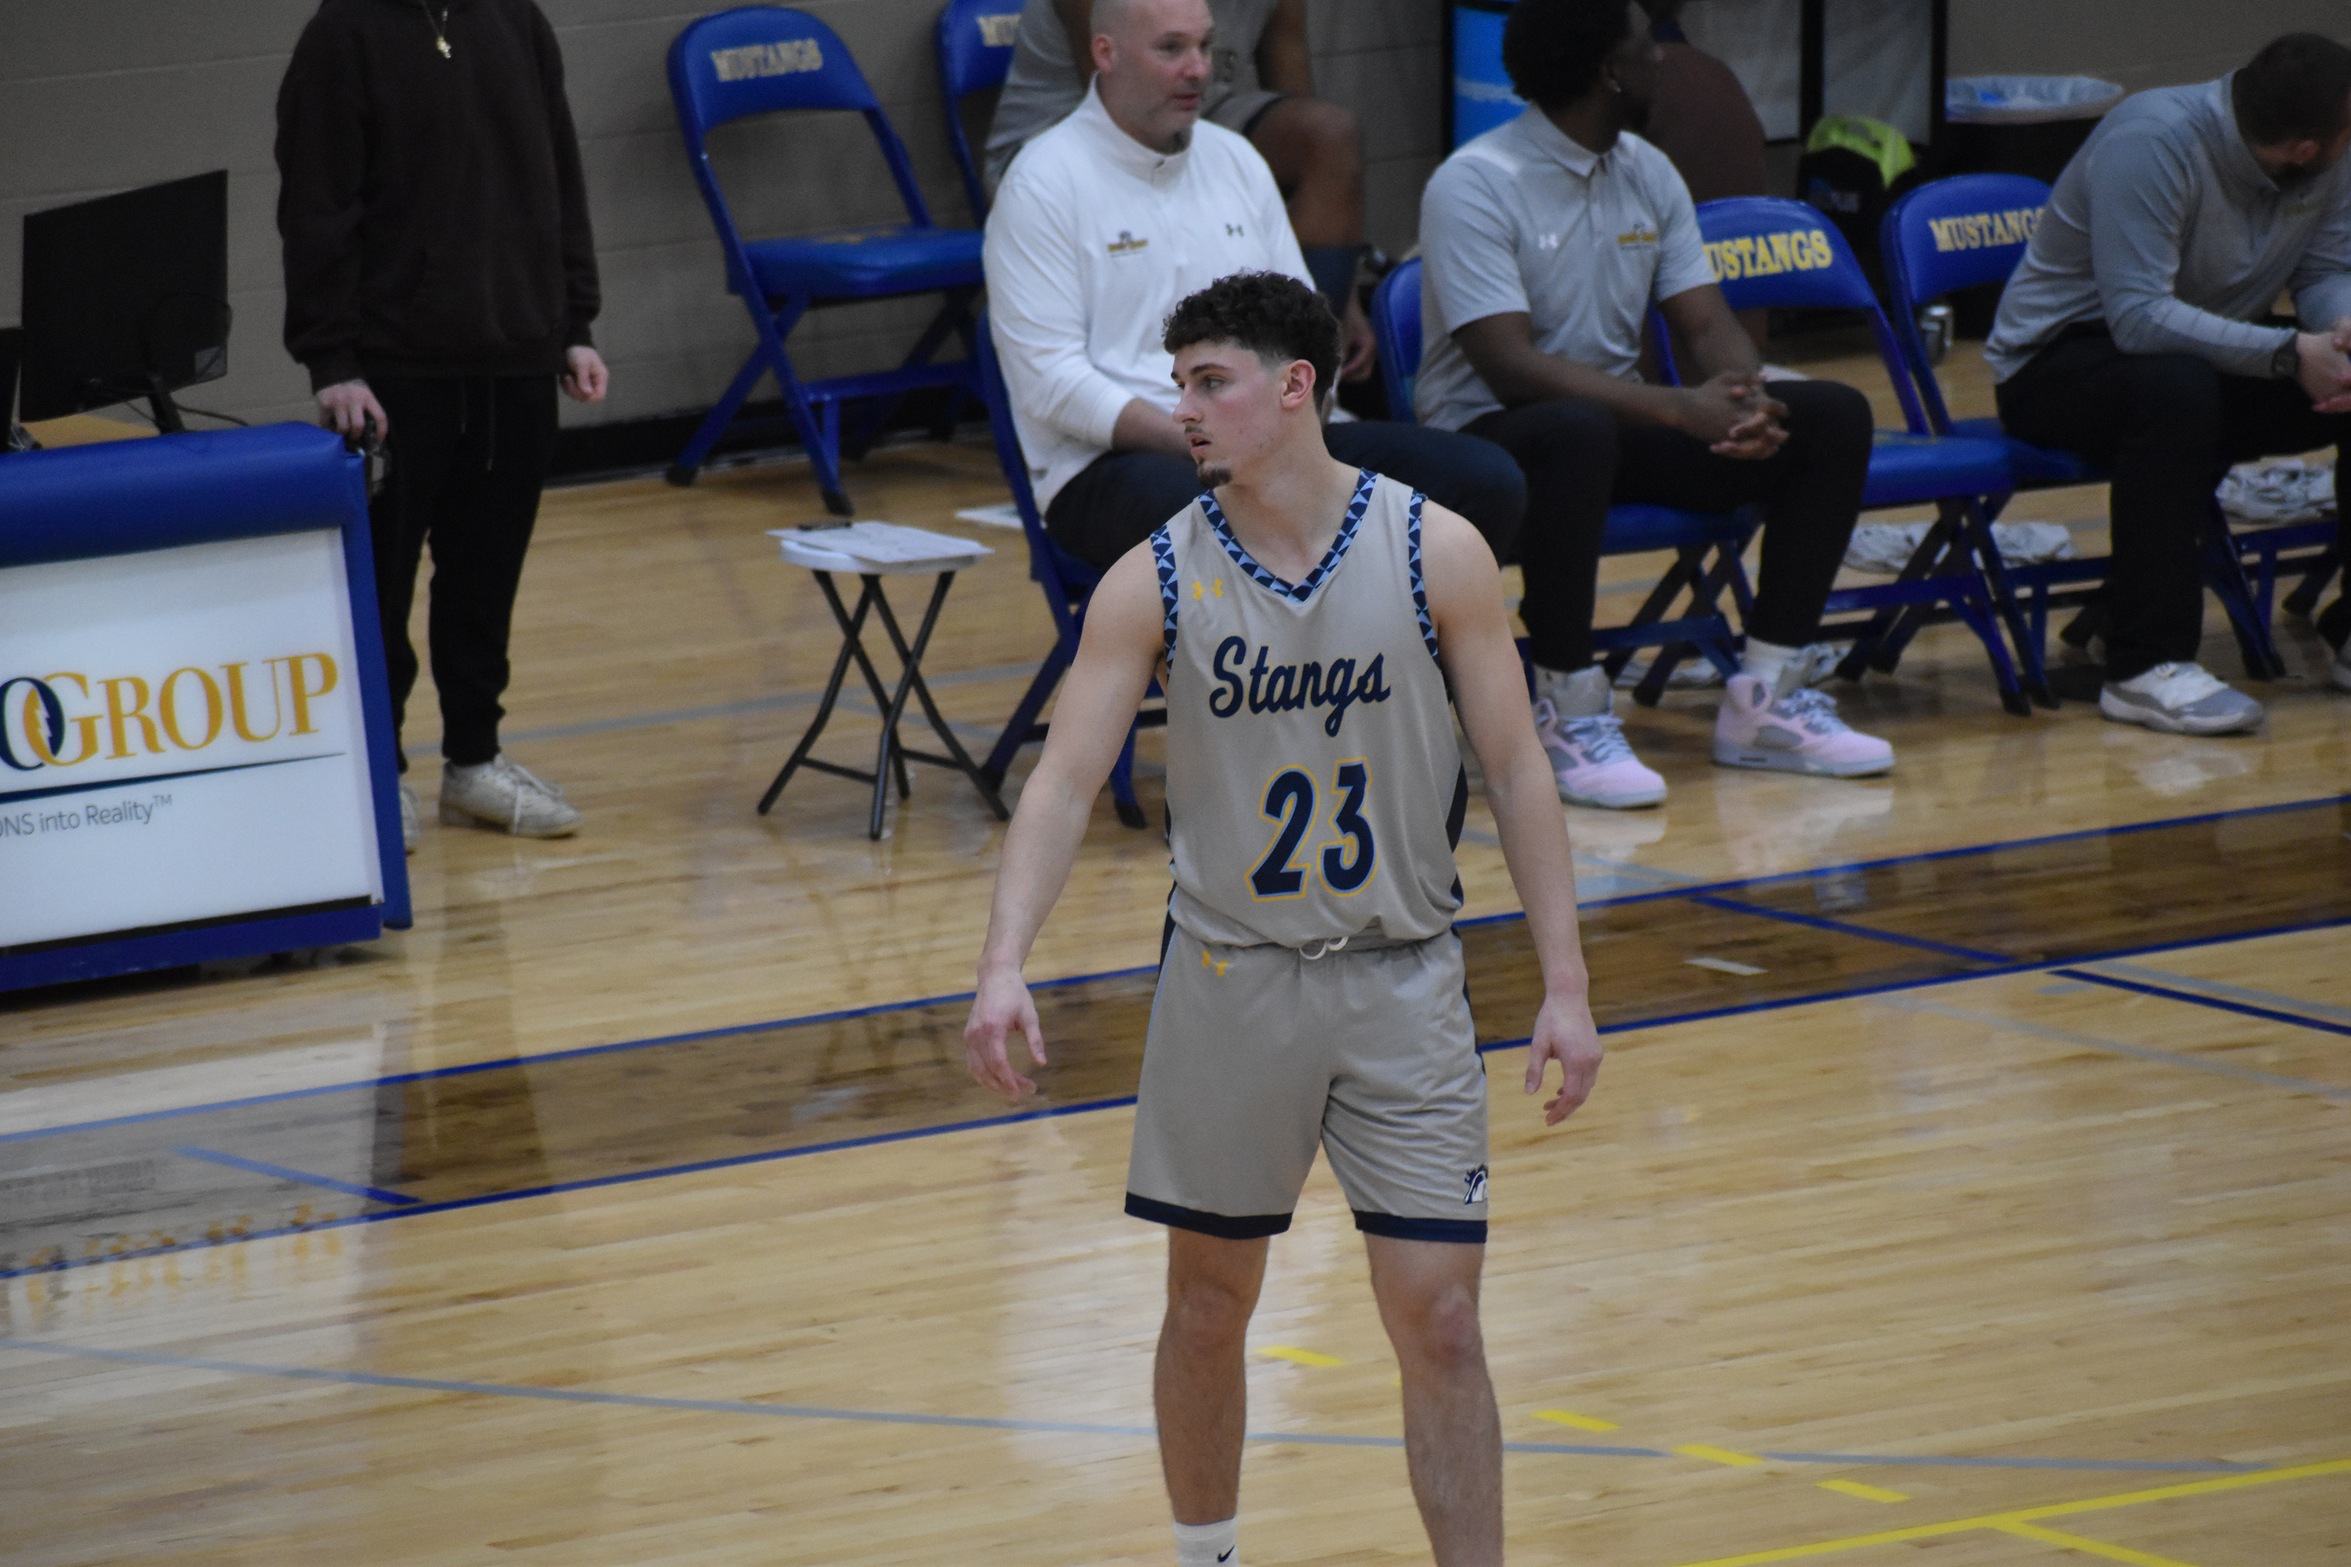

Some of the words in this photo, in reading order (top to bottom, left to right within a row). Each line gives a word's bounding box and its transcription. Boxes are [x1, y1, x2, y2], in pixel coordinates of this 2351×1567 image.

[1703, 229, 1833, 282] USTANGS
[1209, 634, 1392, 738] Stangs
[0, 813, 36, 838] NS
[39, 810, 81, 833] into
[1244, 757, 1379, 902] 23
